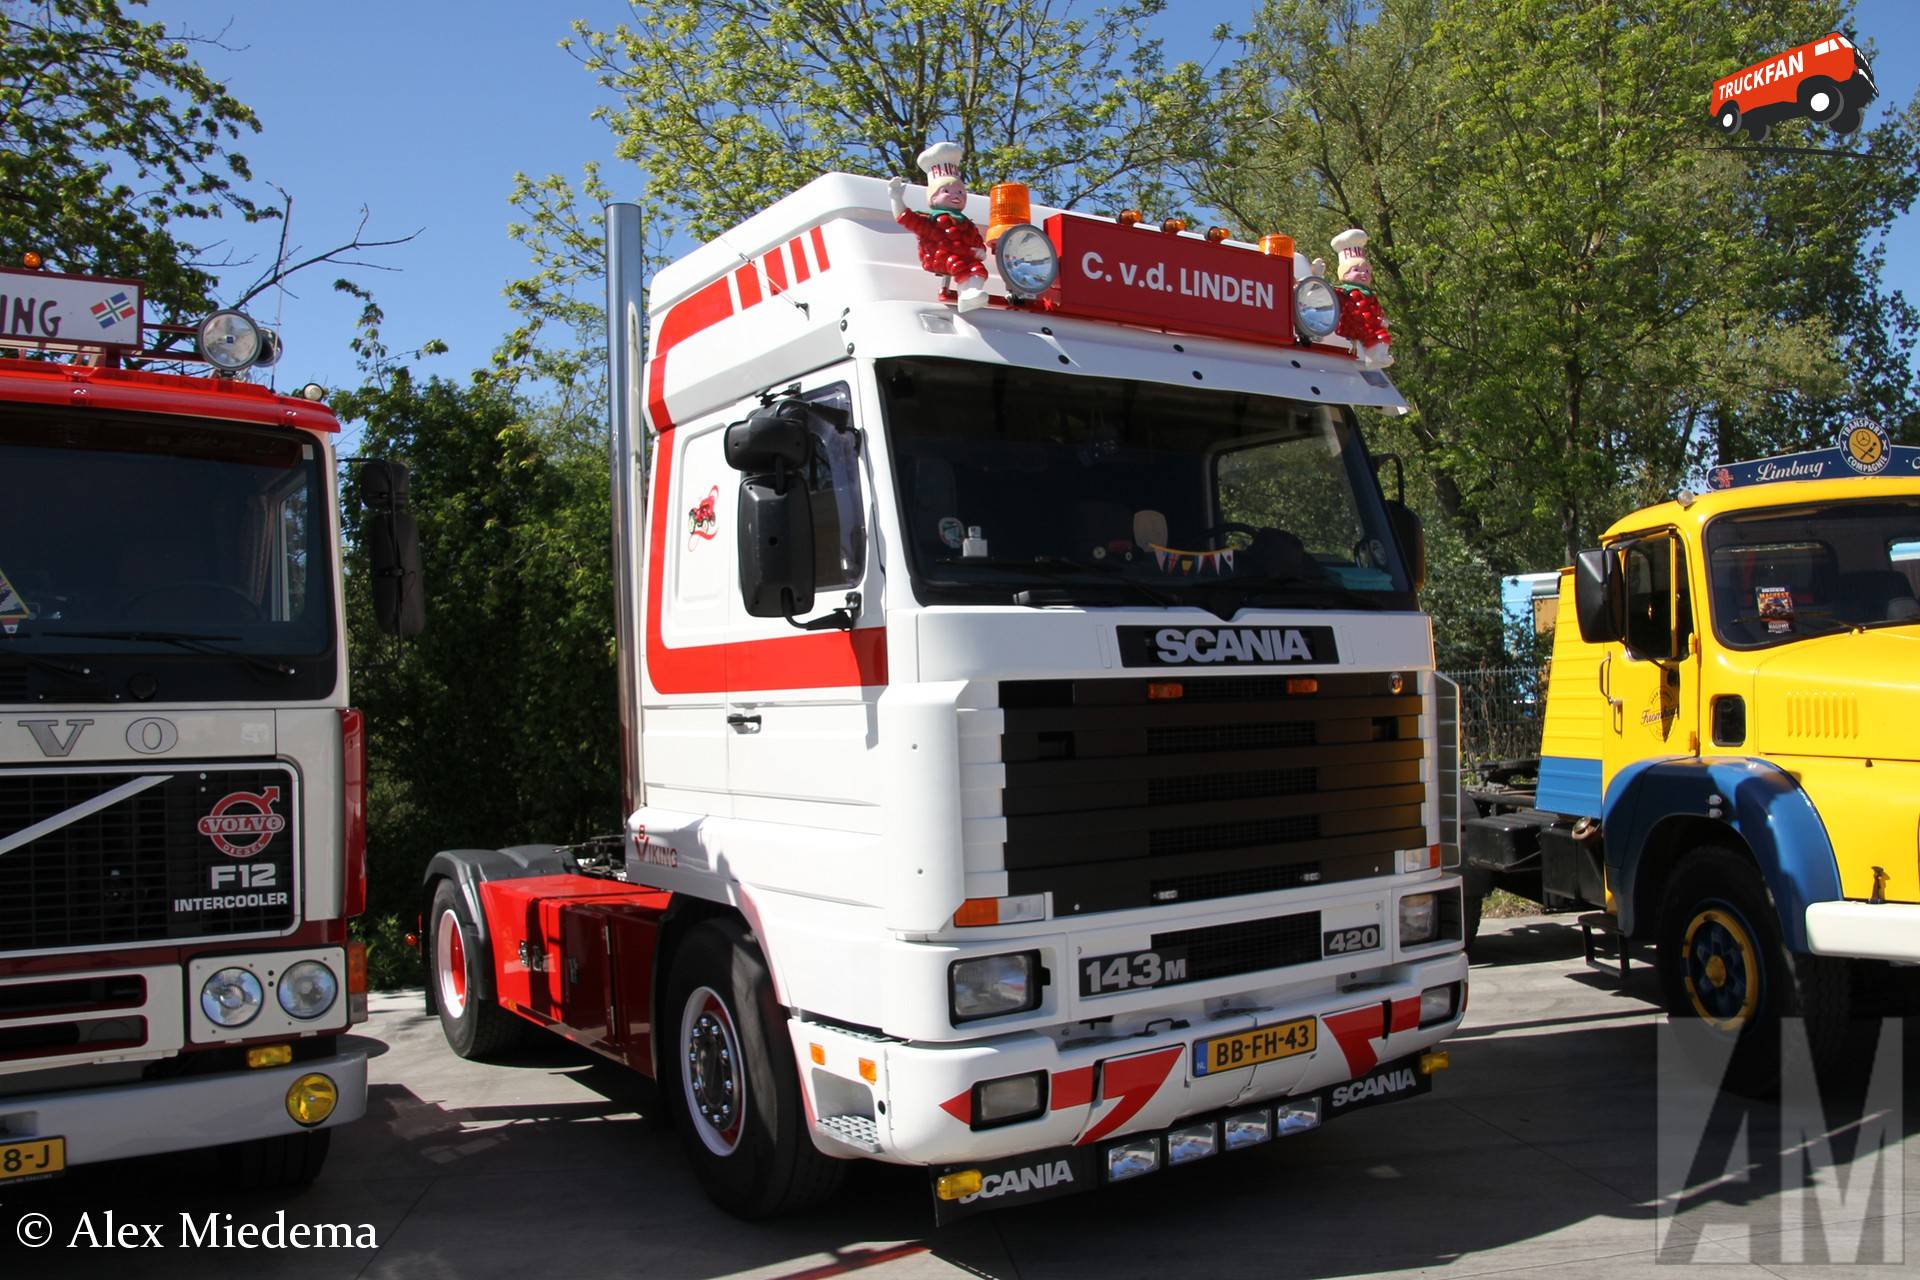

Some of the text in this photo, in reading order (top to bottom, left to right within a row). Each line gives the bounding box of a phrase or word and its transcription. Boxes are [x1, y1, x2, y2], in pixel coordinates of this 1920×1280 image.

[1081, 251, 1274, 310] C. v.d. LINDEN
[1842, 420, 1883, 437] TRANSPORT
[1755, 460, 1825, 483] Limburg
[1847, 455, 1888, 473] COMPAGNIE
[1155, 628, 1313, 664] SCANIA
[206, 816, 283, 833] VOLVO
[223, 841, 265, 855] DIESEL
[634, 836, 678, 868] VIKING
[211, 863, 276, 890] F12
[174, 892, 288, 912] INTERCOOLER
[1328, 927, 1379, 952] 420
[1215, 1024, 1310, 1068] BB-FH-43
[1332, 1067, 1417, 1108] SCANIA
[3, 1144, 50, 1172] 8-J
[959, 1159, 1075, 1204] CANIA
